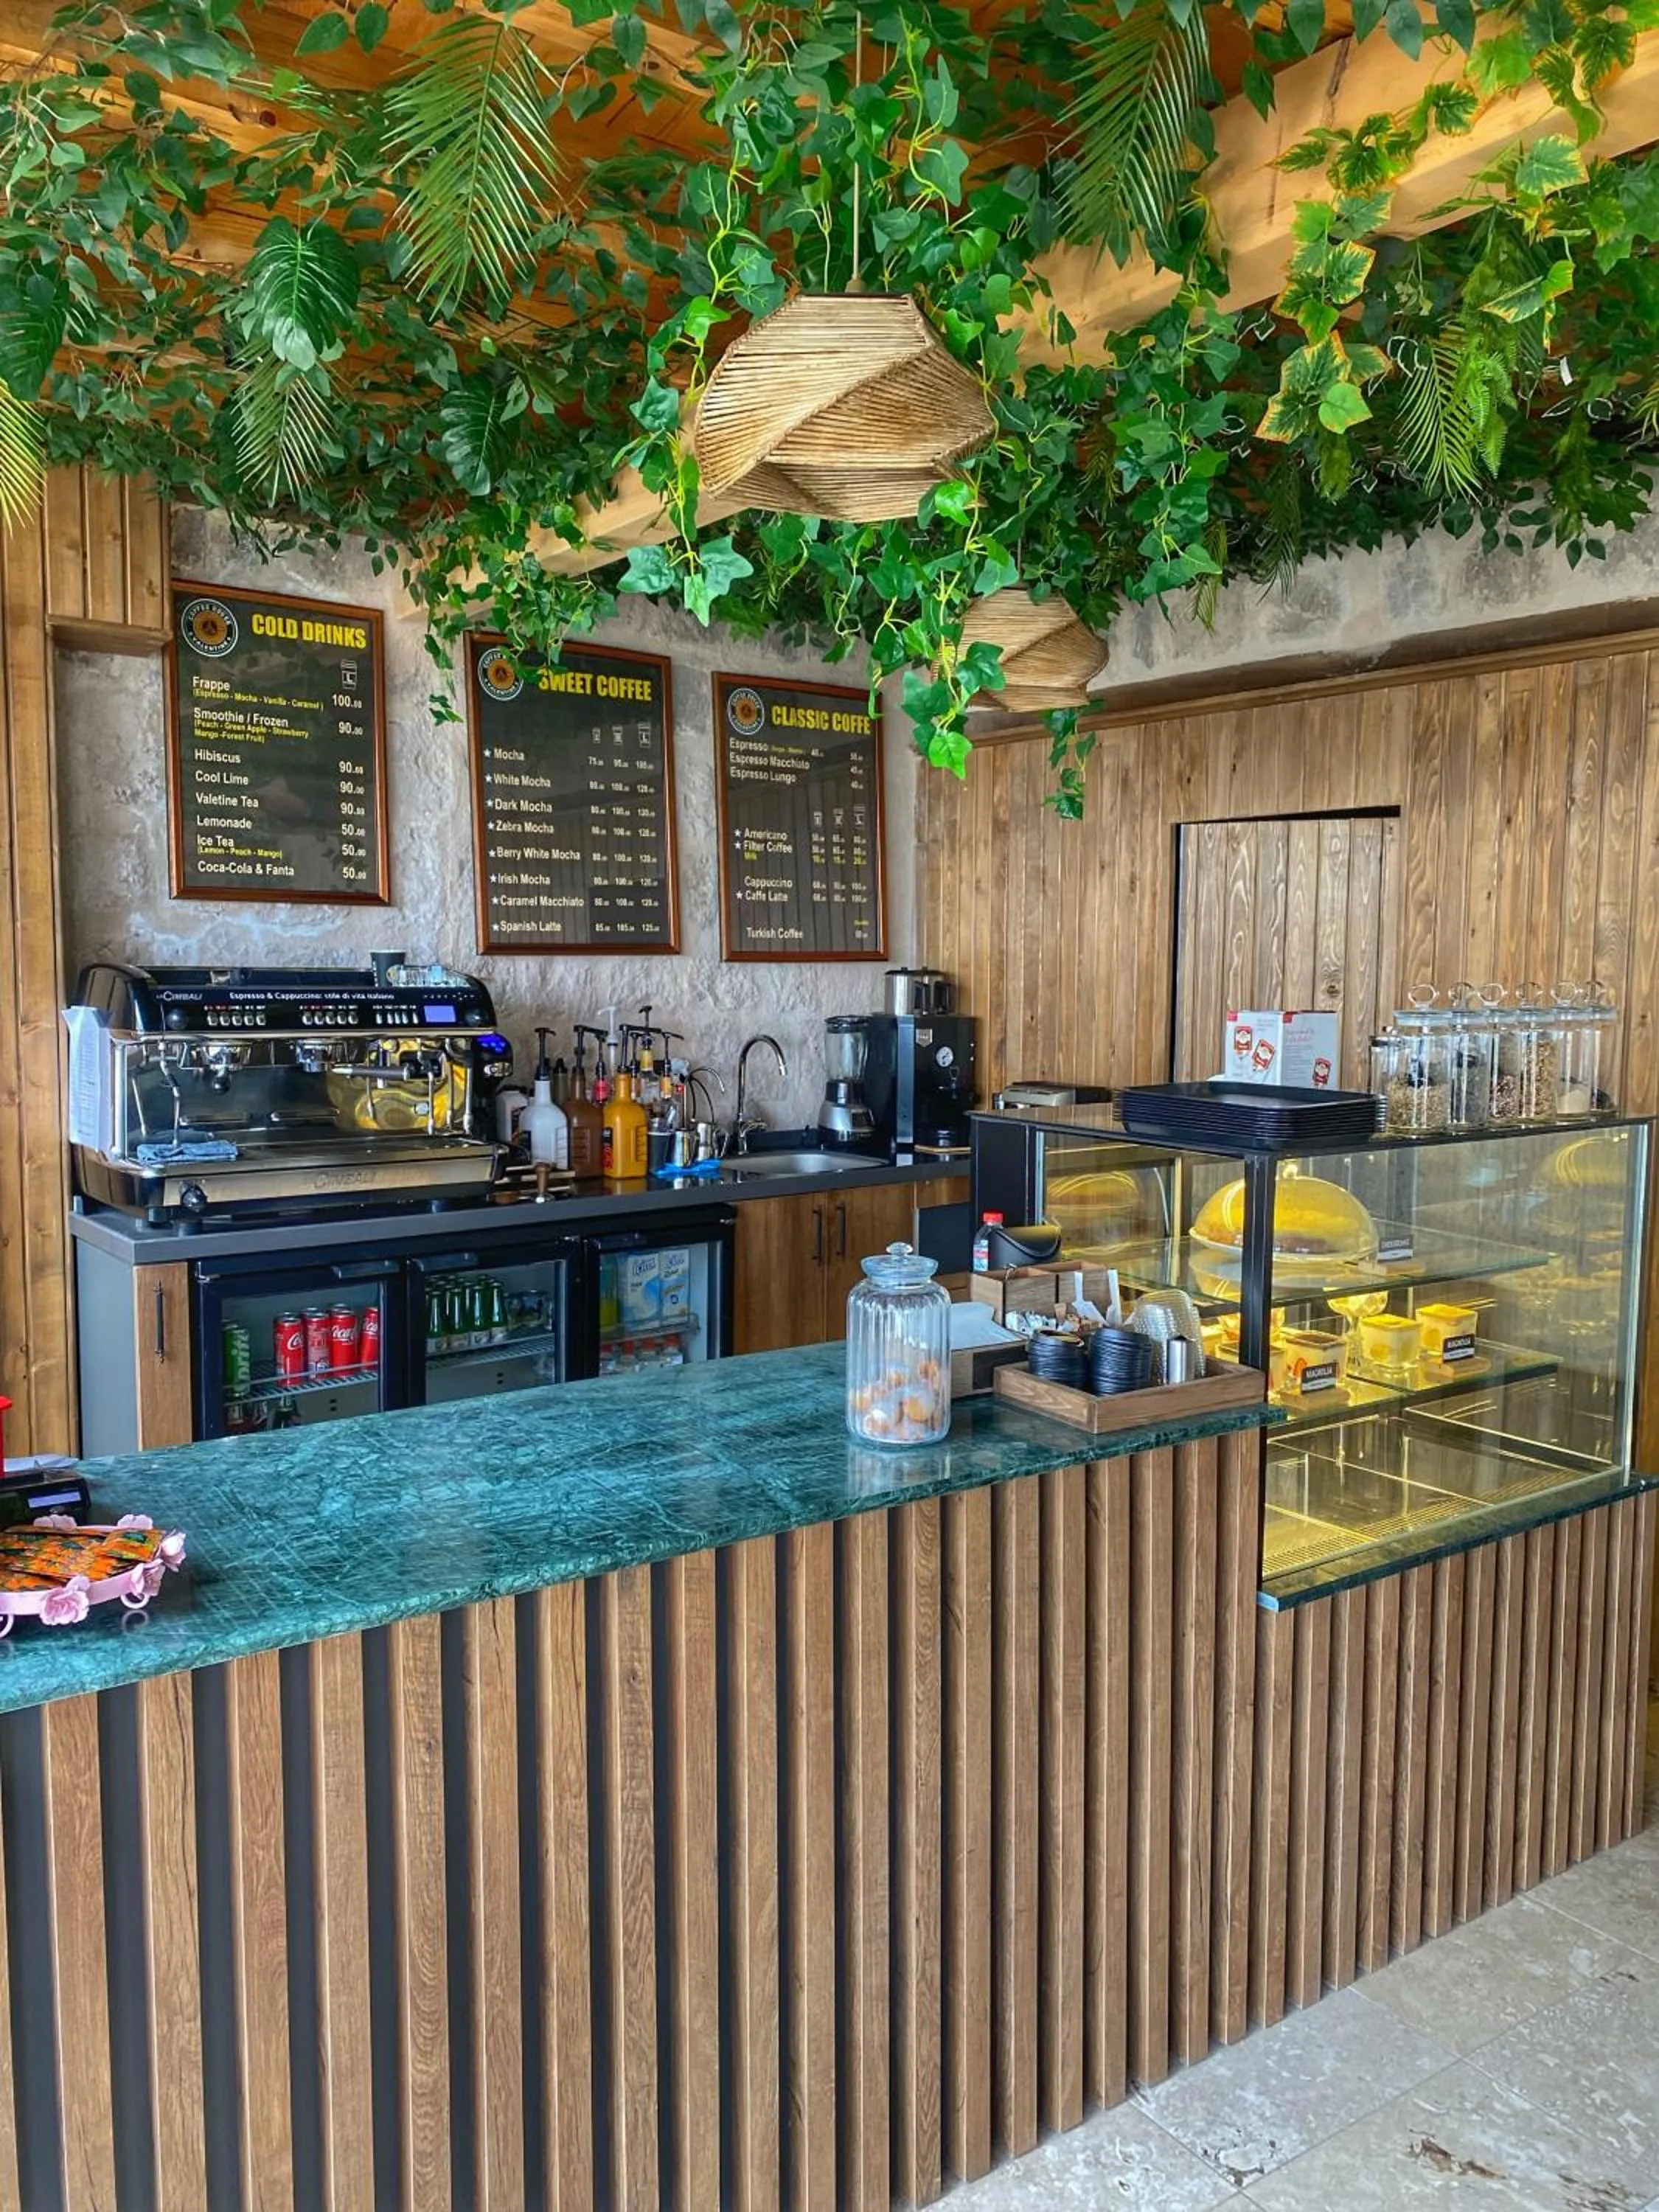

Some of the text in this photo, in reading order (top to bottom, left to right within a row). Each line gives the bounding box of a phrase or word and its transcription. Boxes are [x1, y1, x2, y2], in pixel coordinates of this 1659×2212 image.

[251, 613, 366, 649] COLD DRINKS
[538, 668, 652, 700] SWEET COFFEE
[192, 676, 362, 709] Frappe 100.00
[234, 692, 258, 702] Mocha
[194, 707, 244, 724] Smoothie
[253, 713, 288, 727] Frozen
[338, 721, 364, 736] 90.00
[771, 705, 829, 731] CLASSIC
[729, 737, 768, 751] Espresso
[194, 748, 364, 774] Hibiscus 90.00
[494, 748, 524, 761] Mocha
[729, 752, 768, 767] Espresso
[770, 756, 810, 770] Macchiato
[195, 771, 365, 795] Cool Lime 90.00
[494, 774, 519, 785] White
[521, 776, 551, 787] Mocha
[730, 767, 769, 781] Espresso
[771, 770, 797, 785] Lungo
[195, 792, 239, 807] Valetine
[240, 795, 259, 808] Tea
[495, 799, 518, 810] Dark
[521, 800, 552, 813] Mocha
[197, 815, 252, 830] Lemonade
[496, 820, 521, 832] Zebra
[524, 822, 554, 834] Mocha
[197, 835, 213, 846] Ice
[215, 835, 234, 847] Tea
[745, 828, 787, 841] Americano
[496, 847, 521, 860] Berry
[523, 849, 549, 859] White
[552, 849, 580, 860] Mocha
[745, 841, 765, 851] Filter
[766, 842, 793, 853] Coffee
[198, 860, 253, 874] Coca-Cola
[254, 863, 263, 874] &
[266, 864, 294, 876] Fanta
[498, 874, 518, 885] Irish
[521, 874, 551, 885] Mocha
[745, 876, 793, 889] Cappuccino
[500, 896, 538, 906] Caramel
[539, 896, 585, 907] Macchiato
[768, 891, 788, 902] Latte
[500, 921, 538, 933] Spanish
[539, 922, 561, 931] Latte
[746, 927, 804, 939] Turkish Coffee
[229, 992, 265, 1001] Espresso
